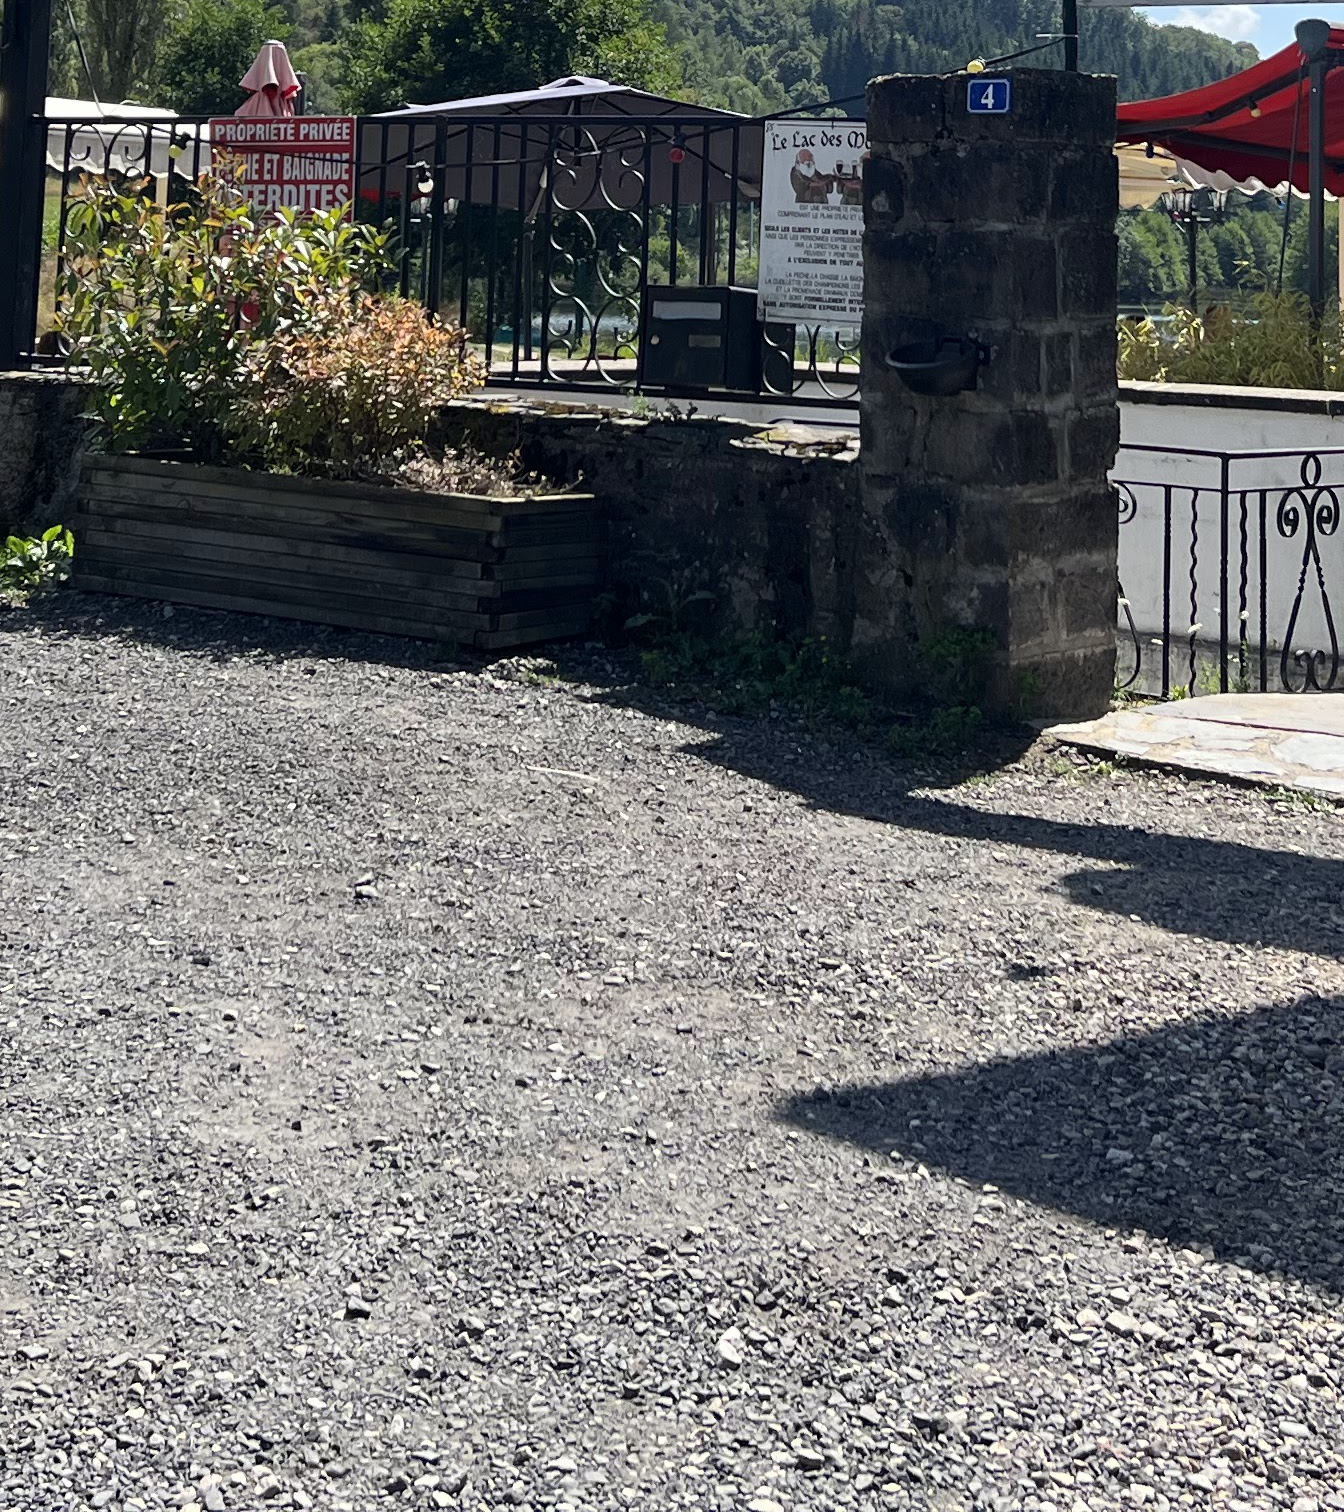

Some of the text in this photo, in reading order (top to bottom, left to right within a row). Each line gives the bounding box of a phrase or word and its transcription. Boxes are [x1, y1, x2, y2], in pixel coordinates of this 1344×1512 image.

[981, 84, 994, 108] 4
[215, 119, 350, 141] PROPRIÉTÉ PRIVÉE
[772, 134, 787, 150] Le
[792, 131, 816, 147] Lac
[821, 130, 842, 147] des
[264, 153, 279, 180] ET
[284, 152, 350, 181] BAIGNADE
